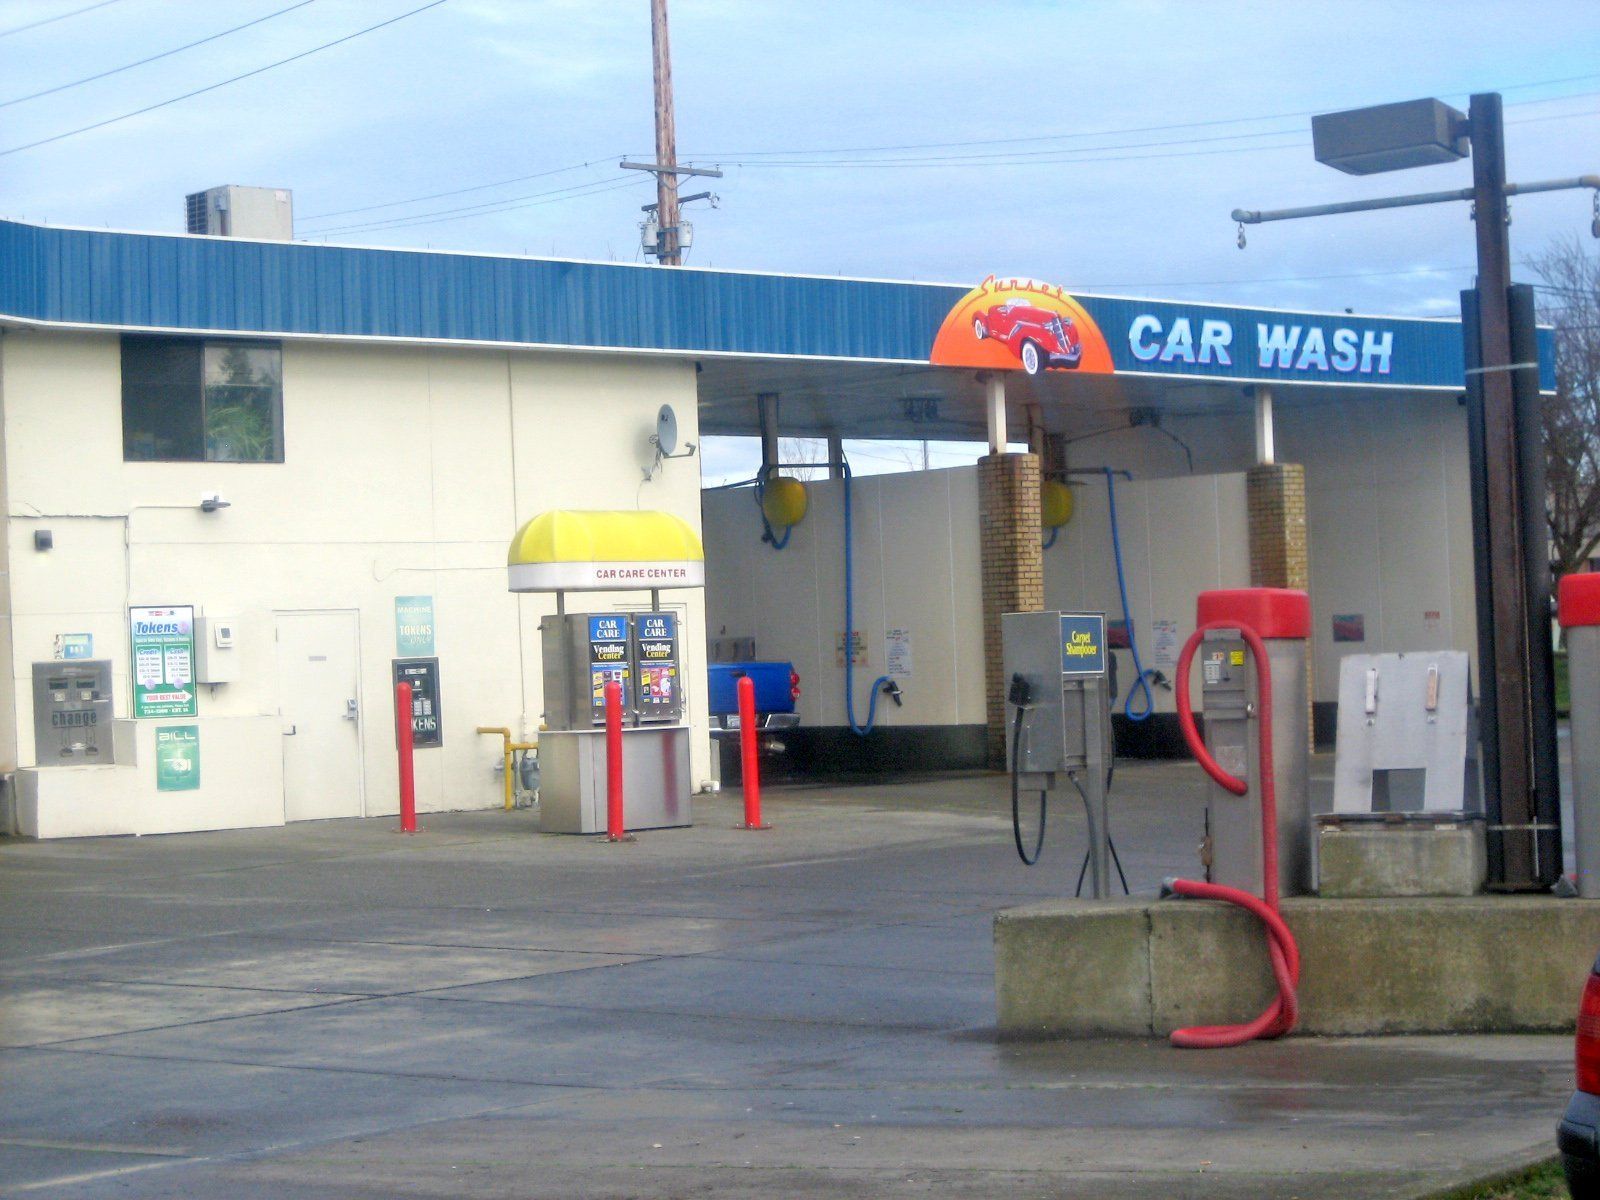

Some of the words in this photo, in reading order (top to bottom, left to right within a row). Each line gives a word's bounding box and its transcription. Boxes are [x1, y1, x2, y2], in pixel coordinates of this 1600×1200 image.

[980, 274, 1064, 301] Sunset
[1128, 314, 1233, 365] CAR
[1257, 323, 1393, 374] WASH
[596, 570, 616, 579] CAR
[619, 569, 645, 578] CARE
[647, 569, 687, 578] CENTER
[136, 621, 179, 634] Tokens
[599, 620, 617, 629] CAR
[646, 619, 664, 628] CAR
[399, 624, 431, 635] TOKENS
[596, 629, 620, 638] CARE
[644, 628, 667, 637] CARE
[1071, 630, 1091, 643] Carpet
[594, 644, 624, 654] Vending
[641, 643, 671, 653] Vending
[598, 652, 621, 660] Center
[646, 650, 668, 658] Center
[52, 711, 97, 727] change
[412, 717, 436, 731] KENS
